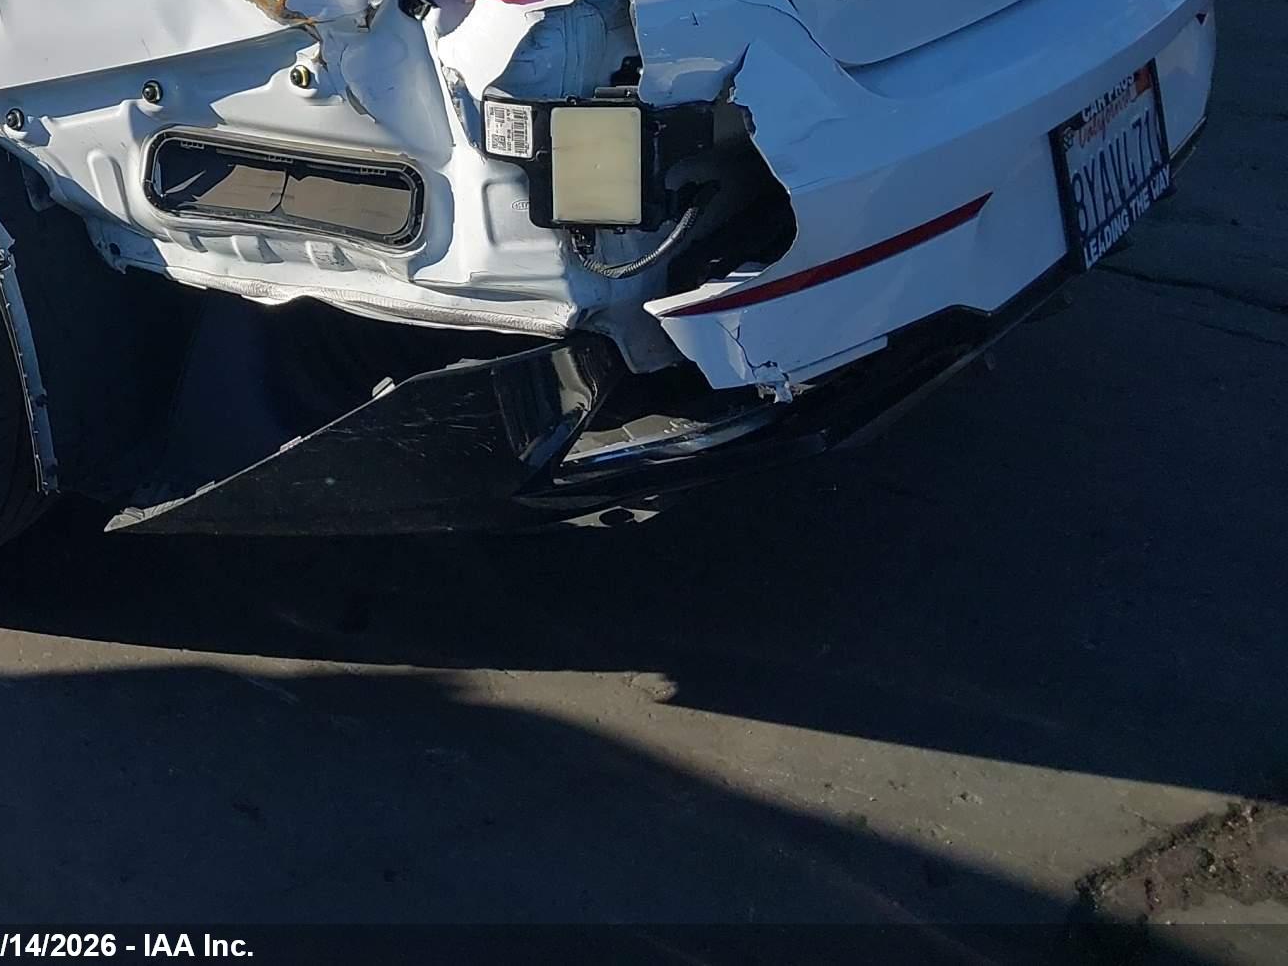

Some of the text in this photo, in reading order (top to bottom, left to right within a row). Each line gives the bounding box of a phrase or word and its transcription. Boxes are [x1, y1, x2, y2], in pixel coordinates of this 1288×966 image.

[1083, 164, 1171, 271] LEADING THE WAY
